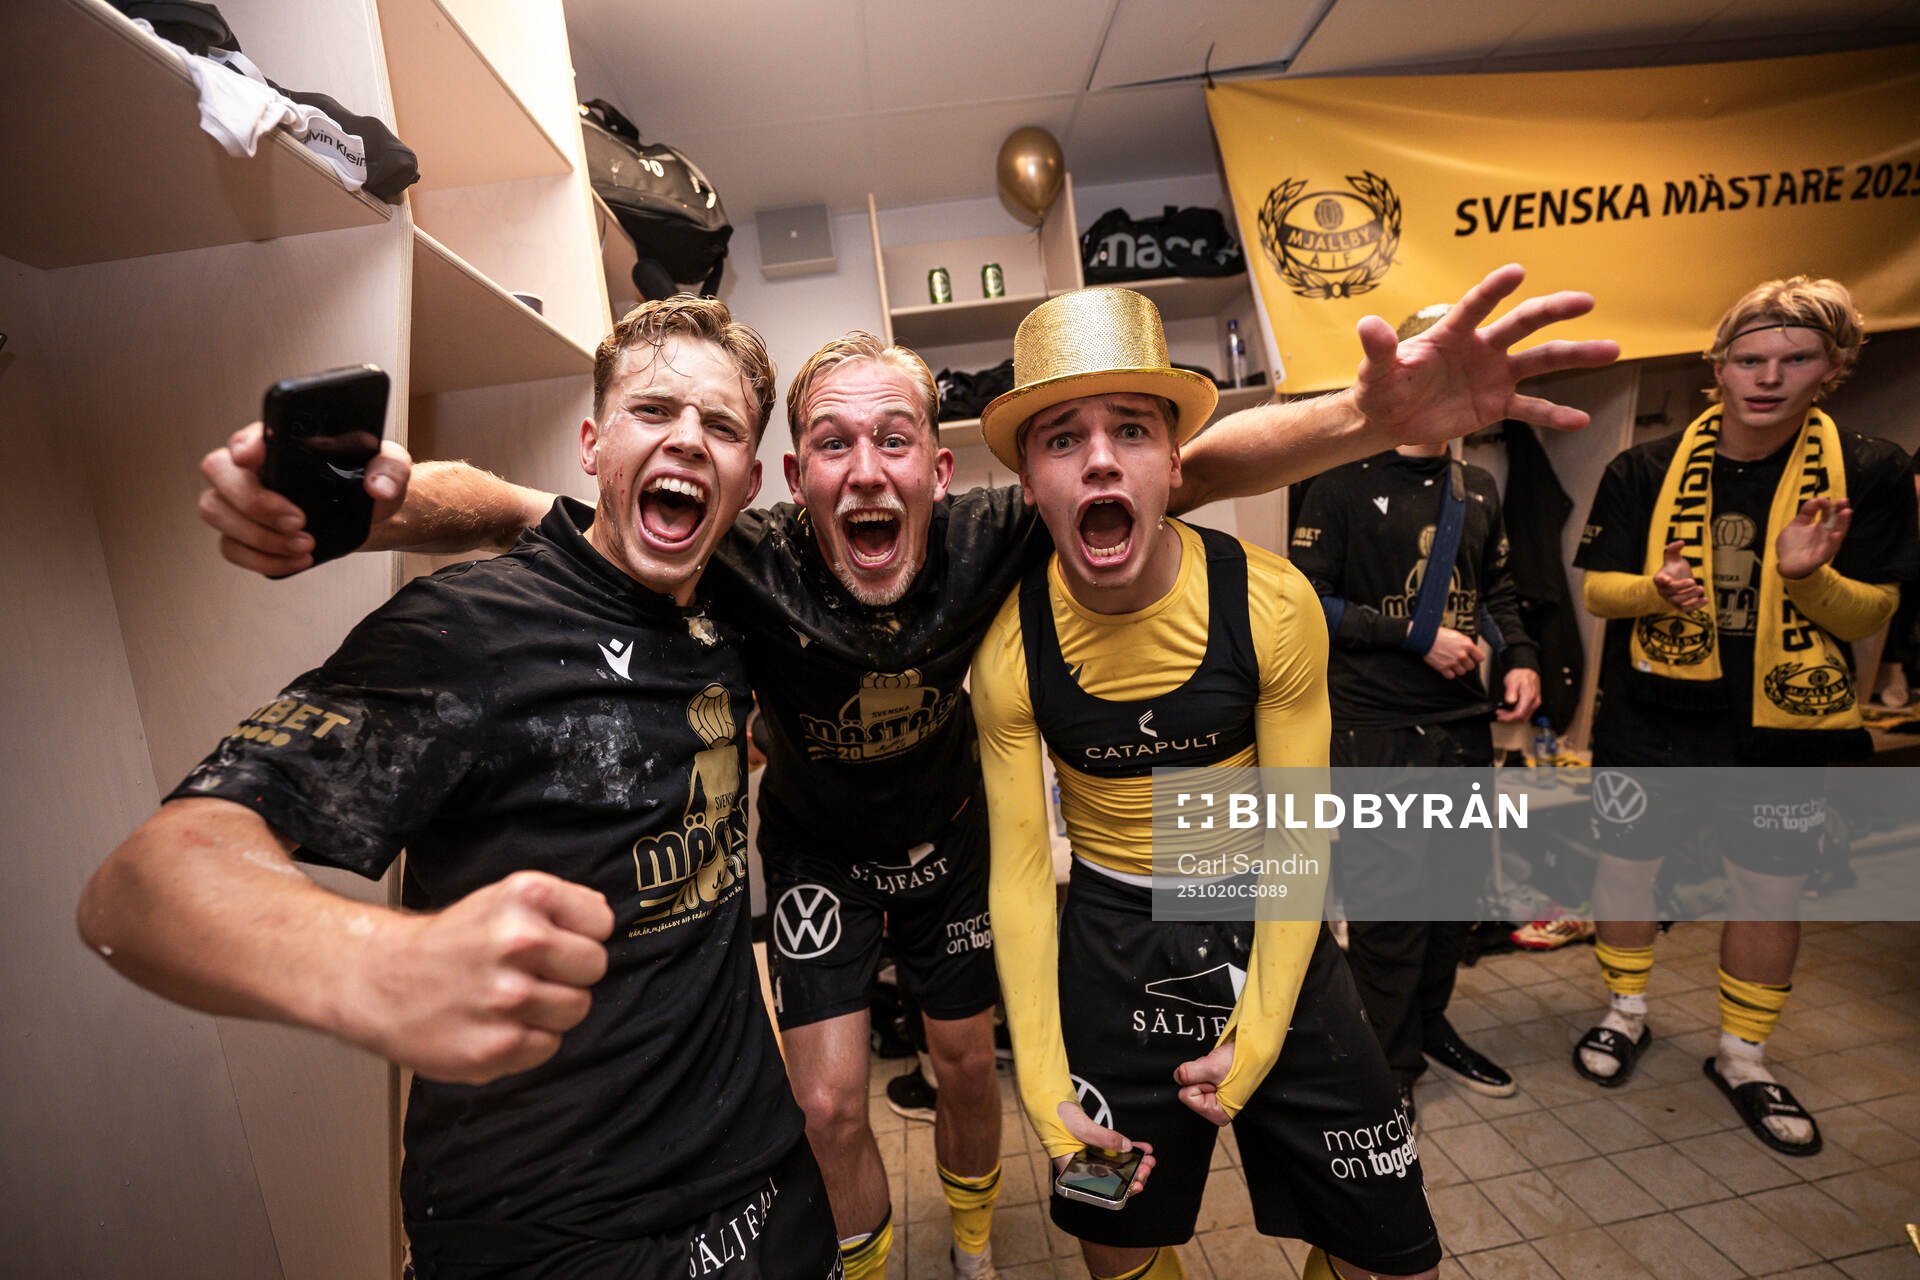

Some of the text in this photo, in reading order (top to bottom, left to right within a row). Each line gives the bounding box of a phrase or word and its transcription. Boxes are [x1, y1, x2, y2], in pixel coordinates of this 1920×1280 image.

[1454, 182, 1650, 237] SVENSKA
[1662, 165, 1845, 216] MÄSTARE
[872, 705, 911, 718] SVENSKA
[1085, 731, 1222, 759] CATAPULT
[1753, 815, 1779, 829] on
[946, 911, 993, 938] marc
[947, 929, 993, 954] on tog
[1331, 1157, 1367, 1179] on
